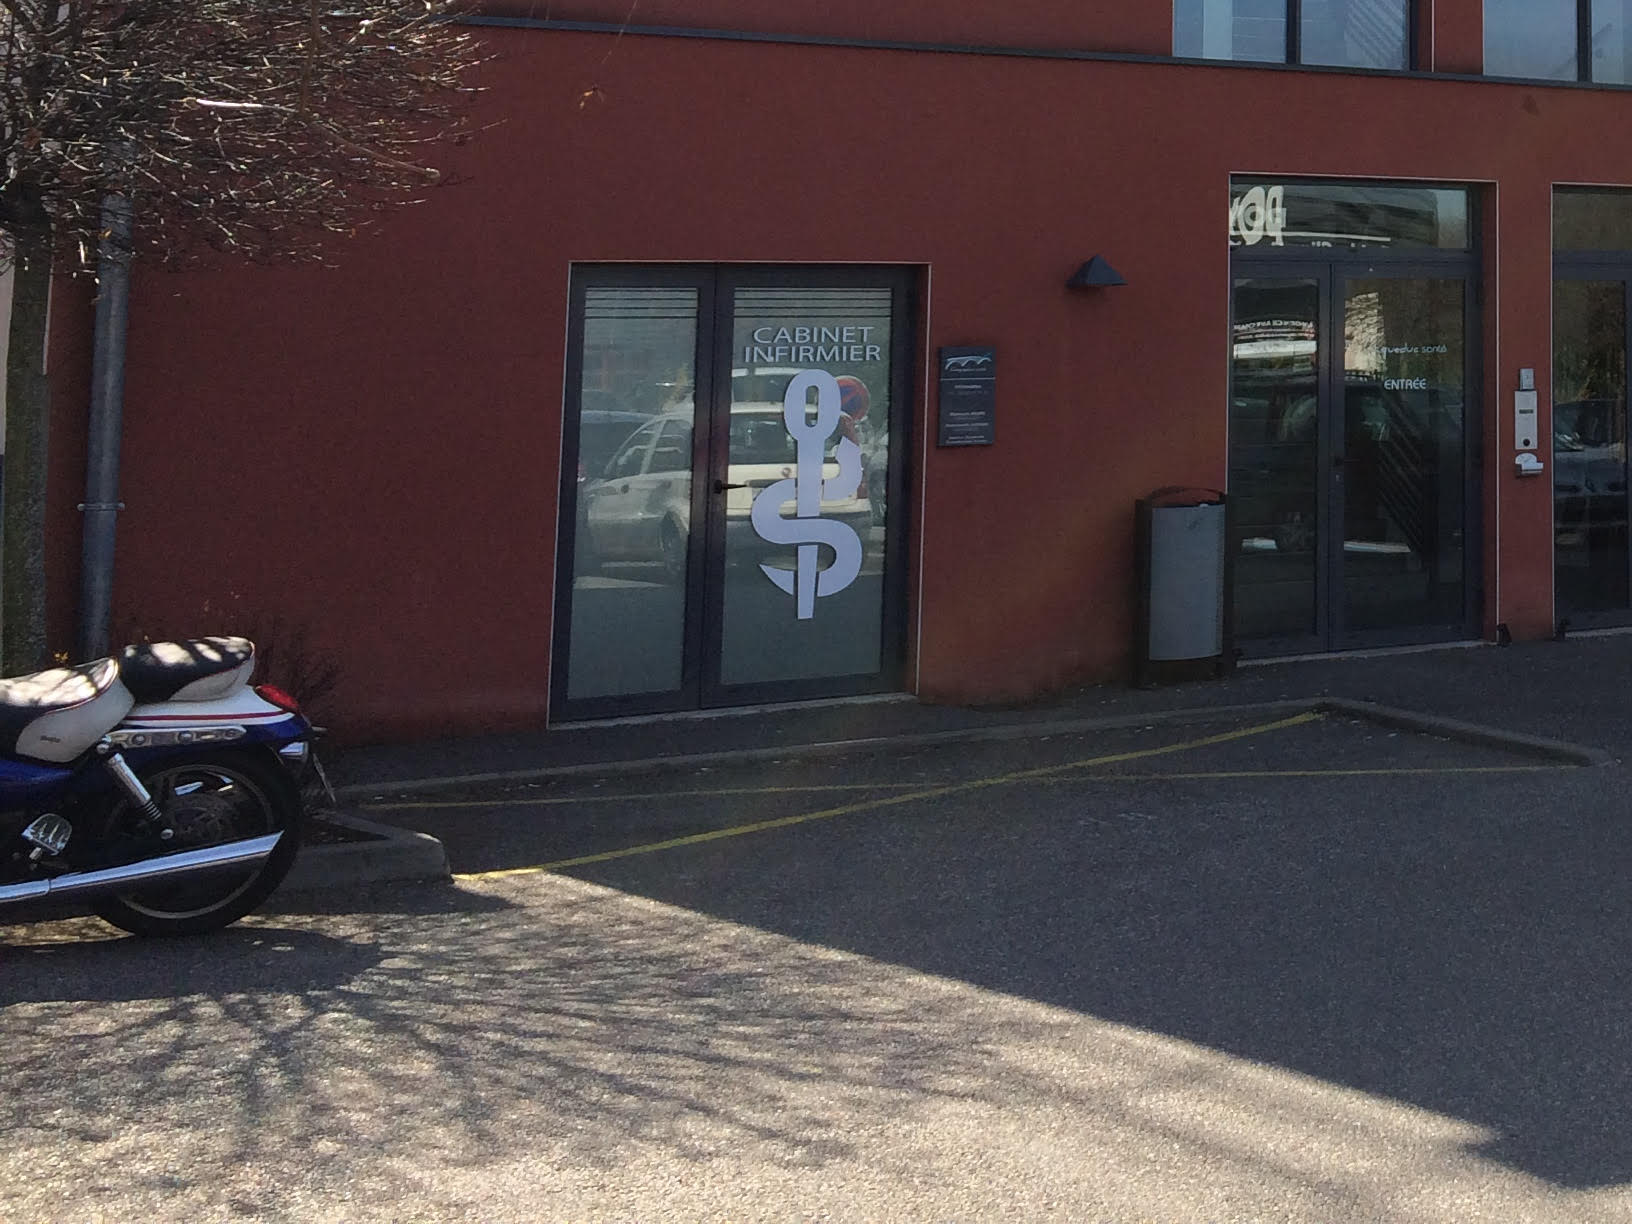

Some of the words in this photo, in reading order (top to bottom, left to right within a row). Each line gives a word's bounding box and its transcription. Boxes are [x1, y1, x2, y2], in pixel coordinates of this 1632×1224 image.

[753, 326, 875, 344] CABINET
[744, 344, 881, 363] INFIRMIER
[1384, 376, 1427, 390] ENTRÉE
